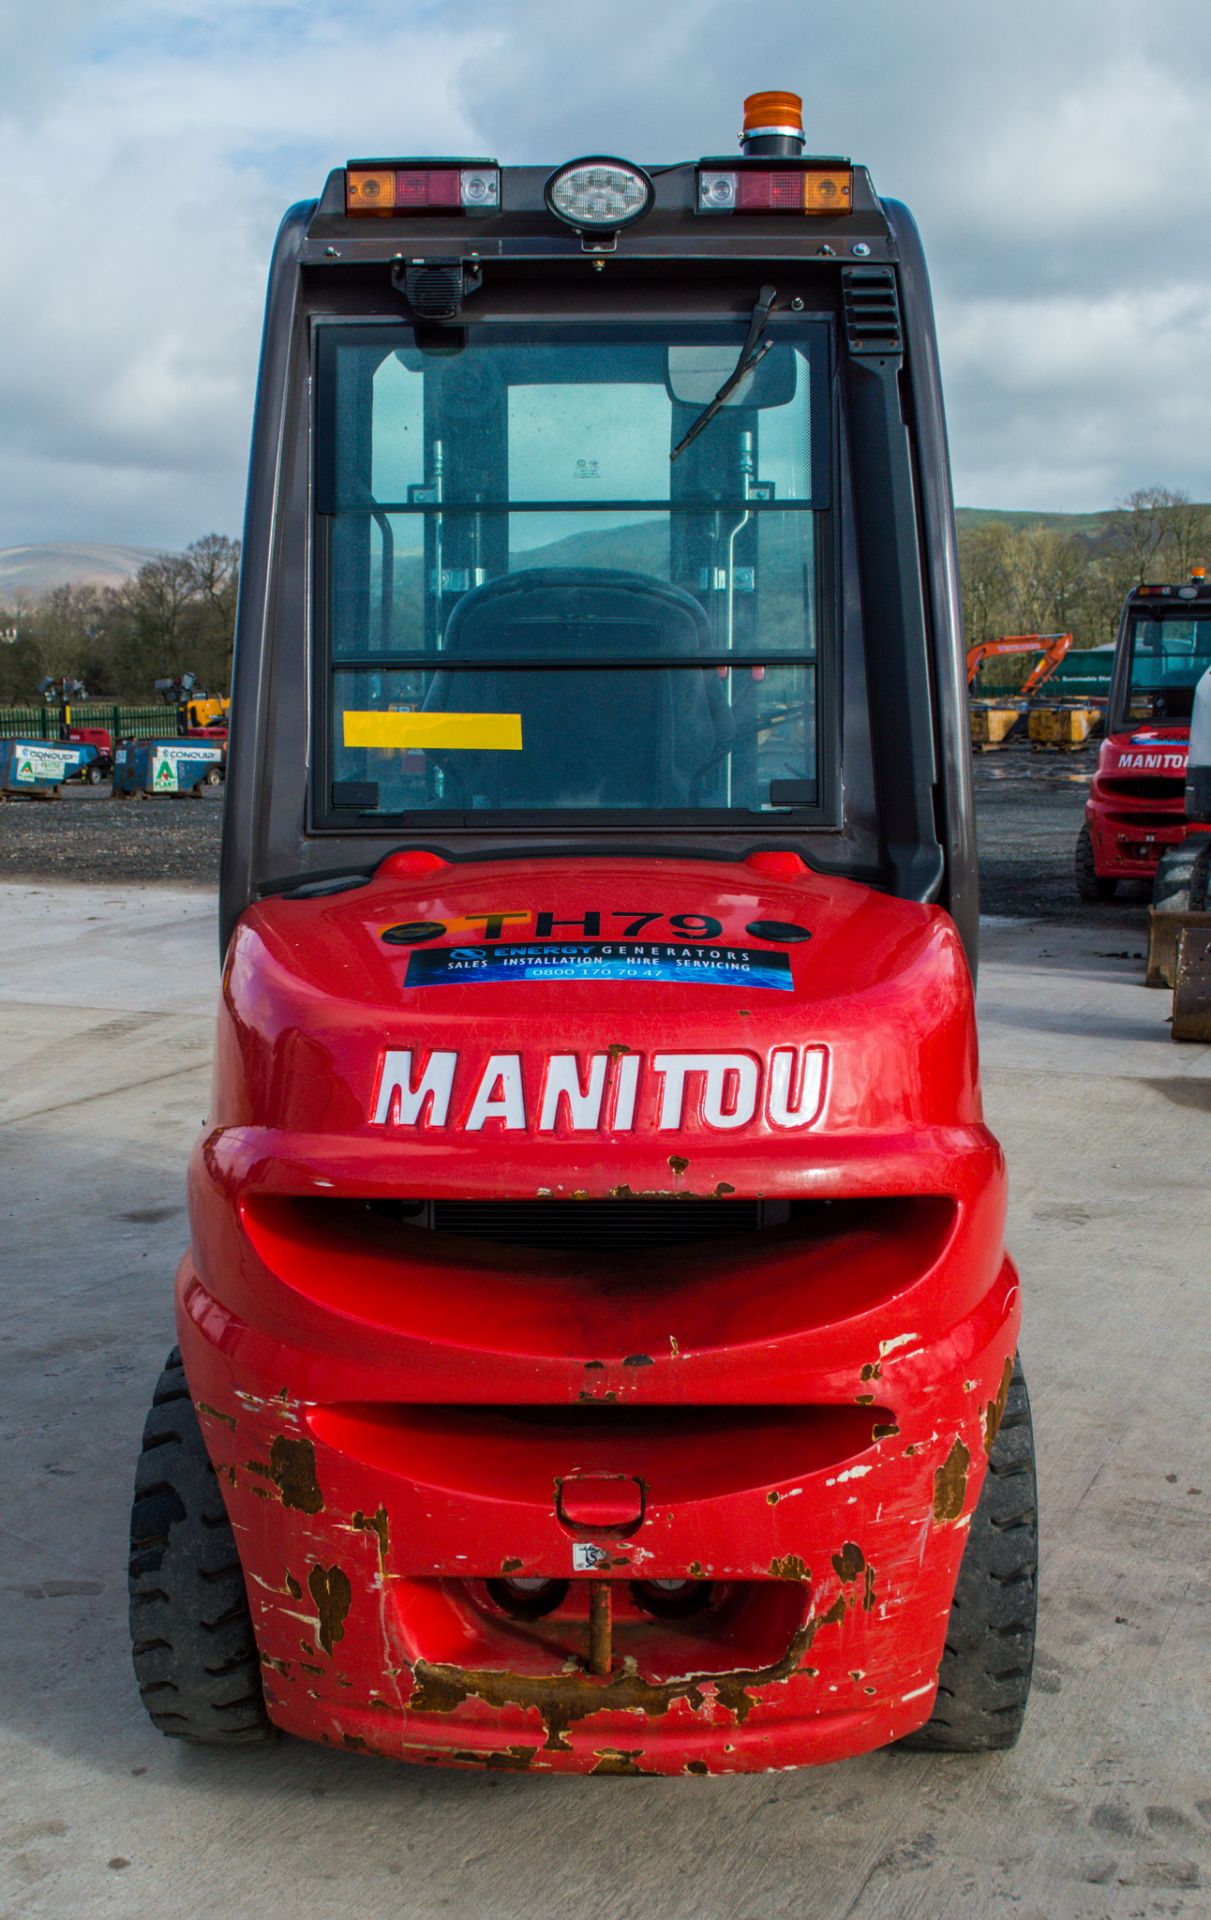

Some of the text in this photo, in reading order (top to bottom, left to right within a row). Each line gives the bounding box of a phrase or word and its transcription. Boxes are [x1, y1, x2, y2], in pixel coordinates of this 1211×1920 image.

[170, 751, 214, 759] CONQUIP
[465, 911, 723, 940] TH79
[494, 946, 750, 961] ENERGY GENERATORS
[447, 957, 750, 971] SALES INSTALLATION HIRE SERVICING
[532, 968, 663, 977] 0800 170 70 47
[372, 1043, 827, 1131] MANITOU
